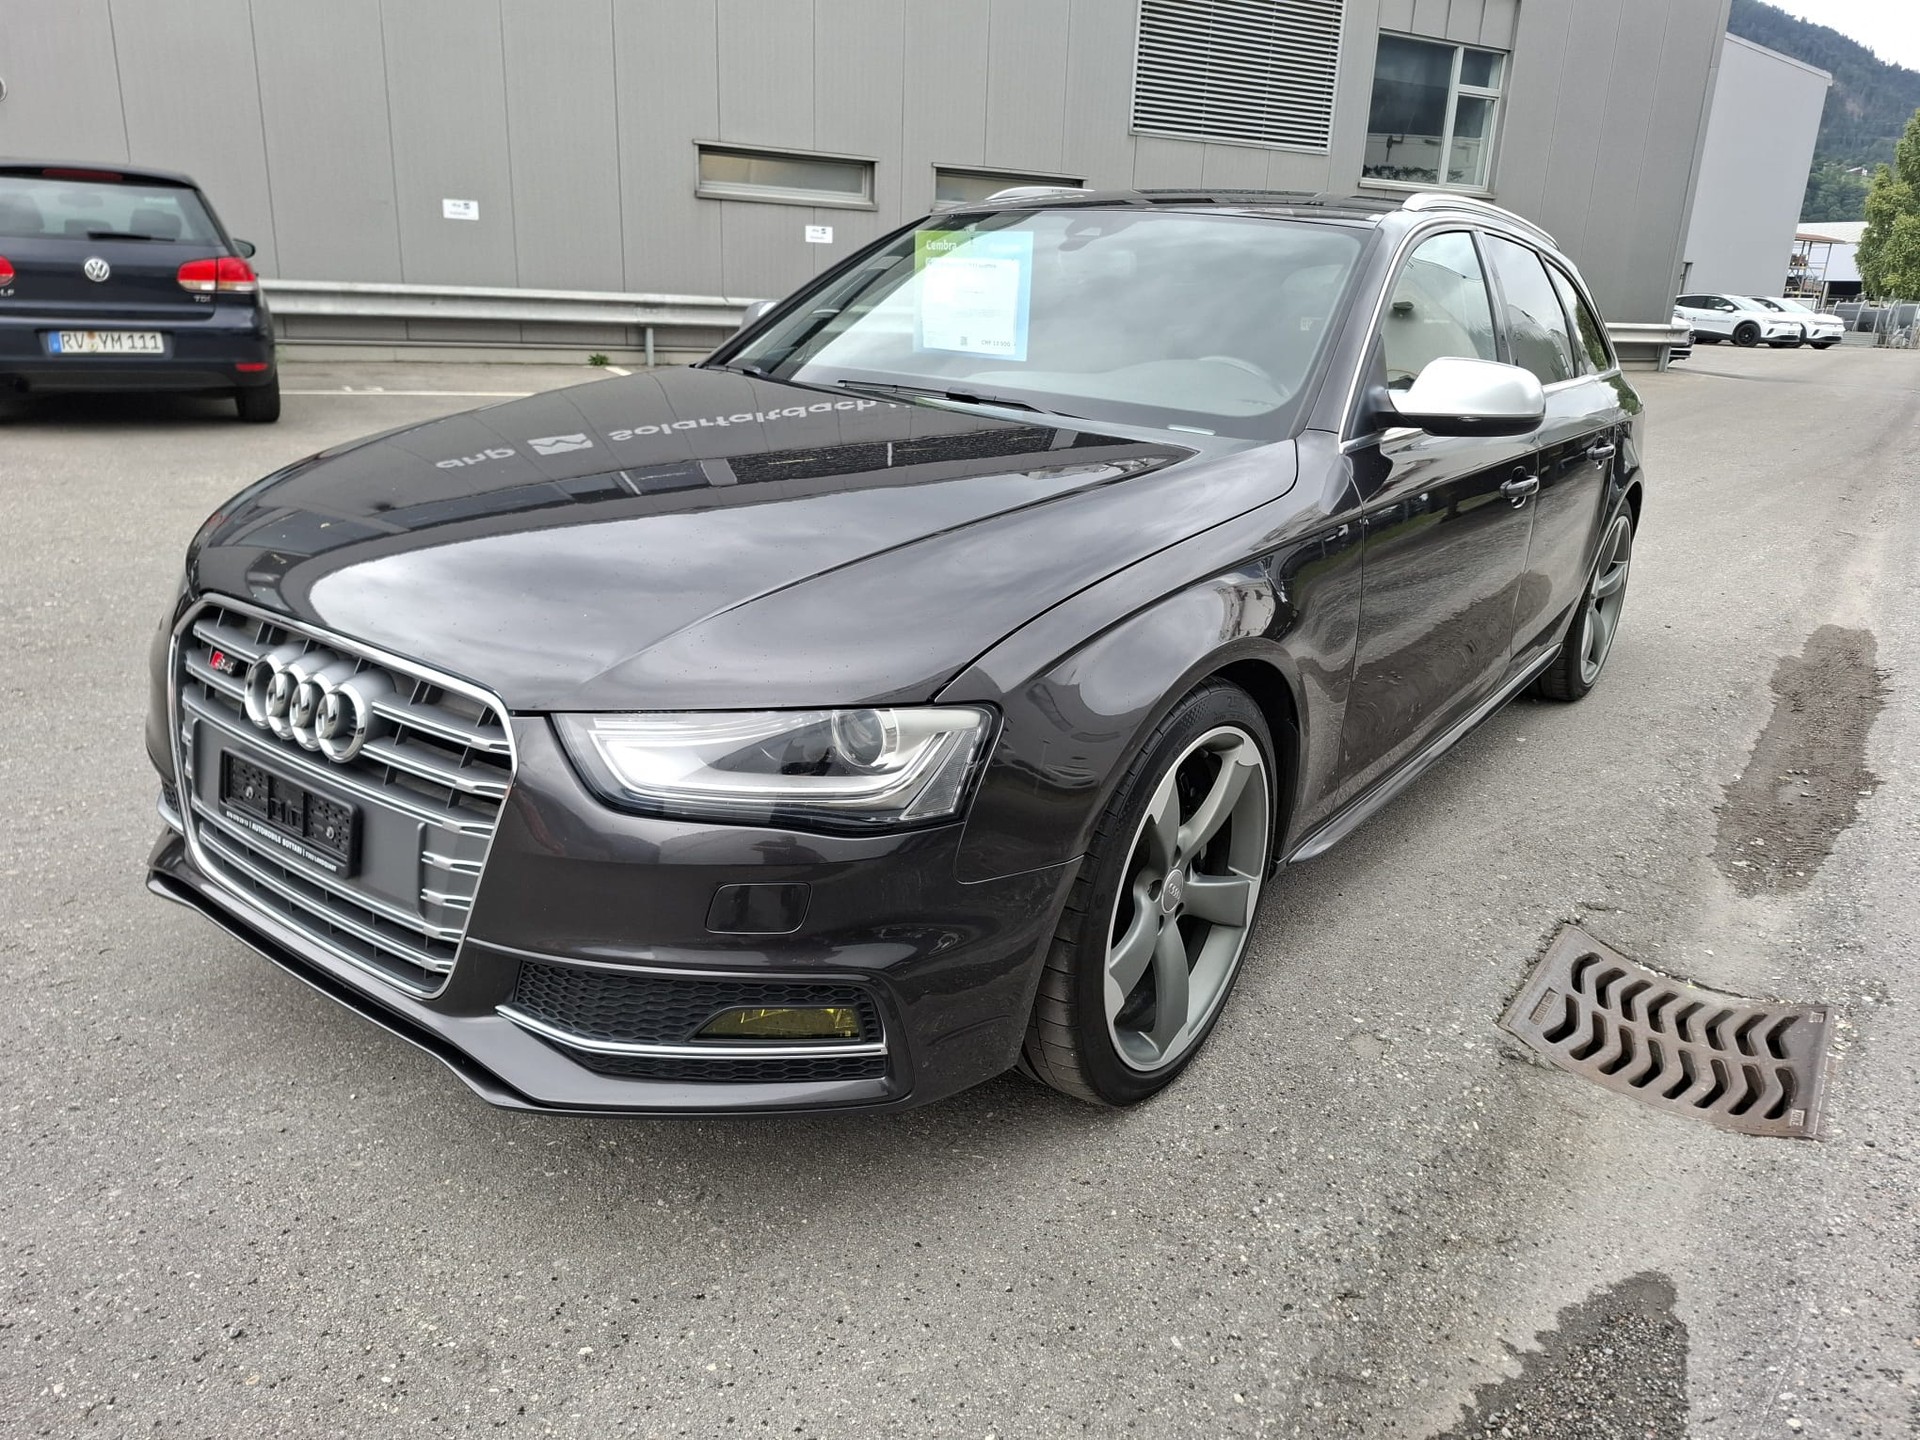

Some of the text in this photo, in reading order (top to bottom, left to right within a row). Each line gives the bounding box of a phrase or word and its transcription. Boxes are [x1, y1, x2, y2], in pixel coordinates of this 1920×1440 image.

[926, 240, 957, 251] Cembra
[61, 333, 161, 350] RV YM 111
